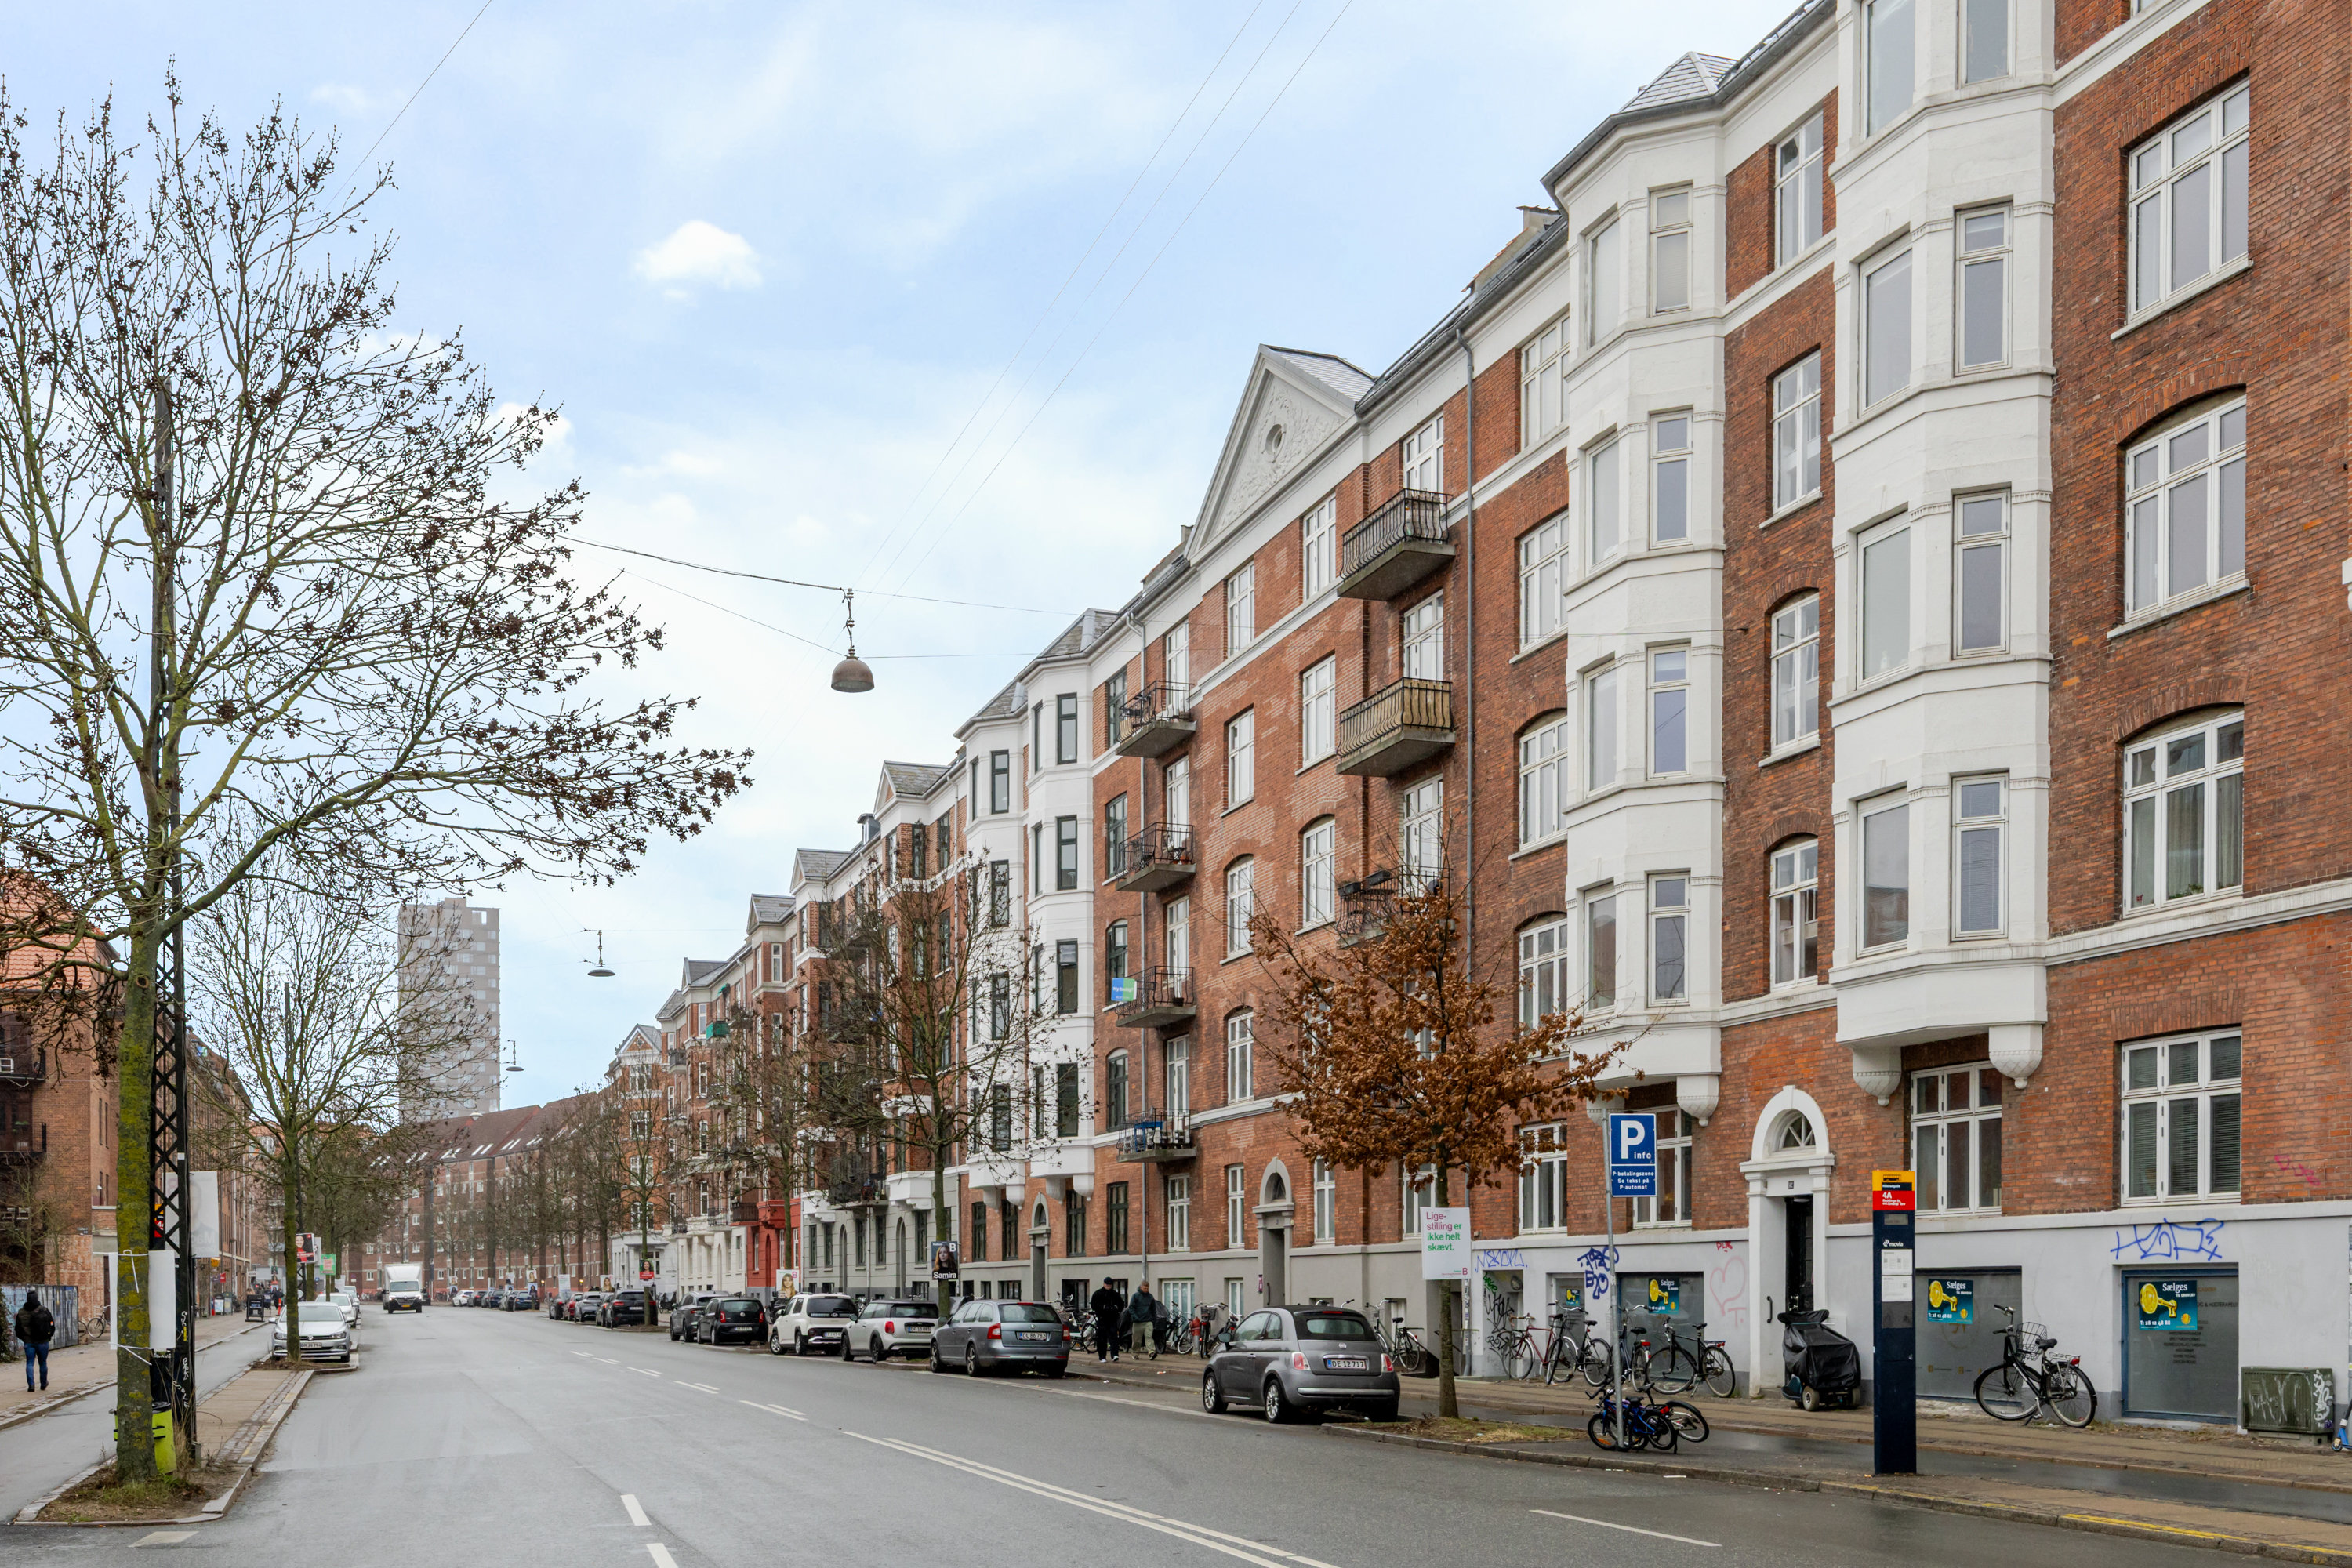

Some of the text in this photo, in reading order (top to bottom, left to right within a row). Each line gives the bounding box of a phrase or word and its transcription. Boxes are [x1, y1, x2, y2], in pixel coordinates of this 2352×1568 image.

[1621, 1120, 1645, 1159] P
[1426, 1211, 1446, 1221] Lige-
[1427, 1222, 1453, 1232] stilling
[949, 1243, 956, 1252] B
[1428, 1243, 1454, 1251] skævt.
[1946, 1281, 1966, 1290] Sælges
[2162, 1283, 2187, 1294] Sælges
